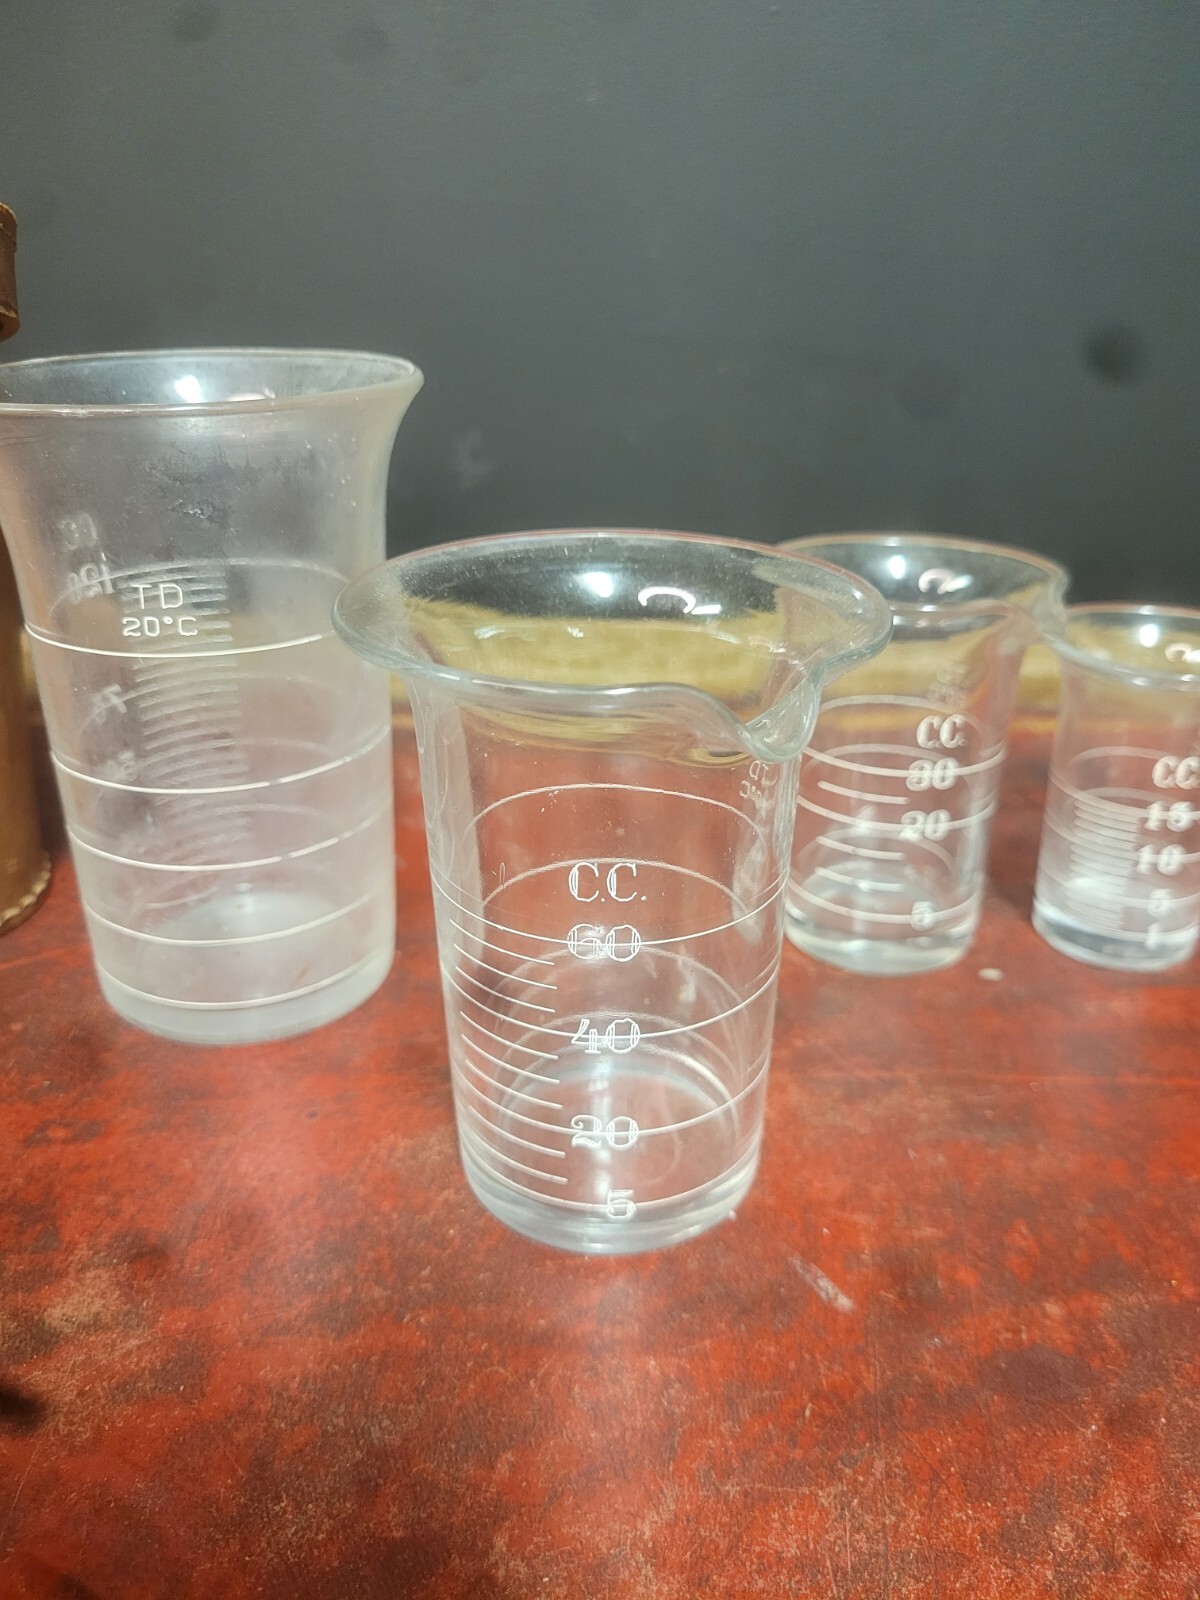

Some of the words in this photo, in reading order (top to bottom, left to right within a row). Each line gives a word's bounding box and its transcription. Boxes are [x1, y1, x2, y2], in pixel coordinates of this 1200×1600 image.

[130, 583, 184, 610] TD
[121, 615, 199, 637] 20°C
[900, 809, 951, 842] 20
[566, 923, 642, 962] 60
[571, 1017, 641, 1055] 40
[571, 1113, 640, 1150] 20
[604, 1188, 638, 1221] 5
